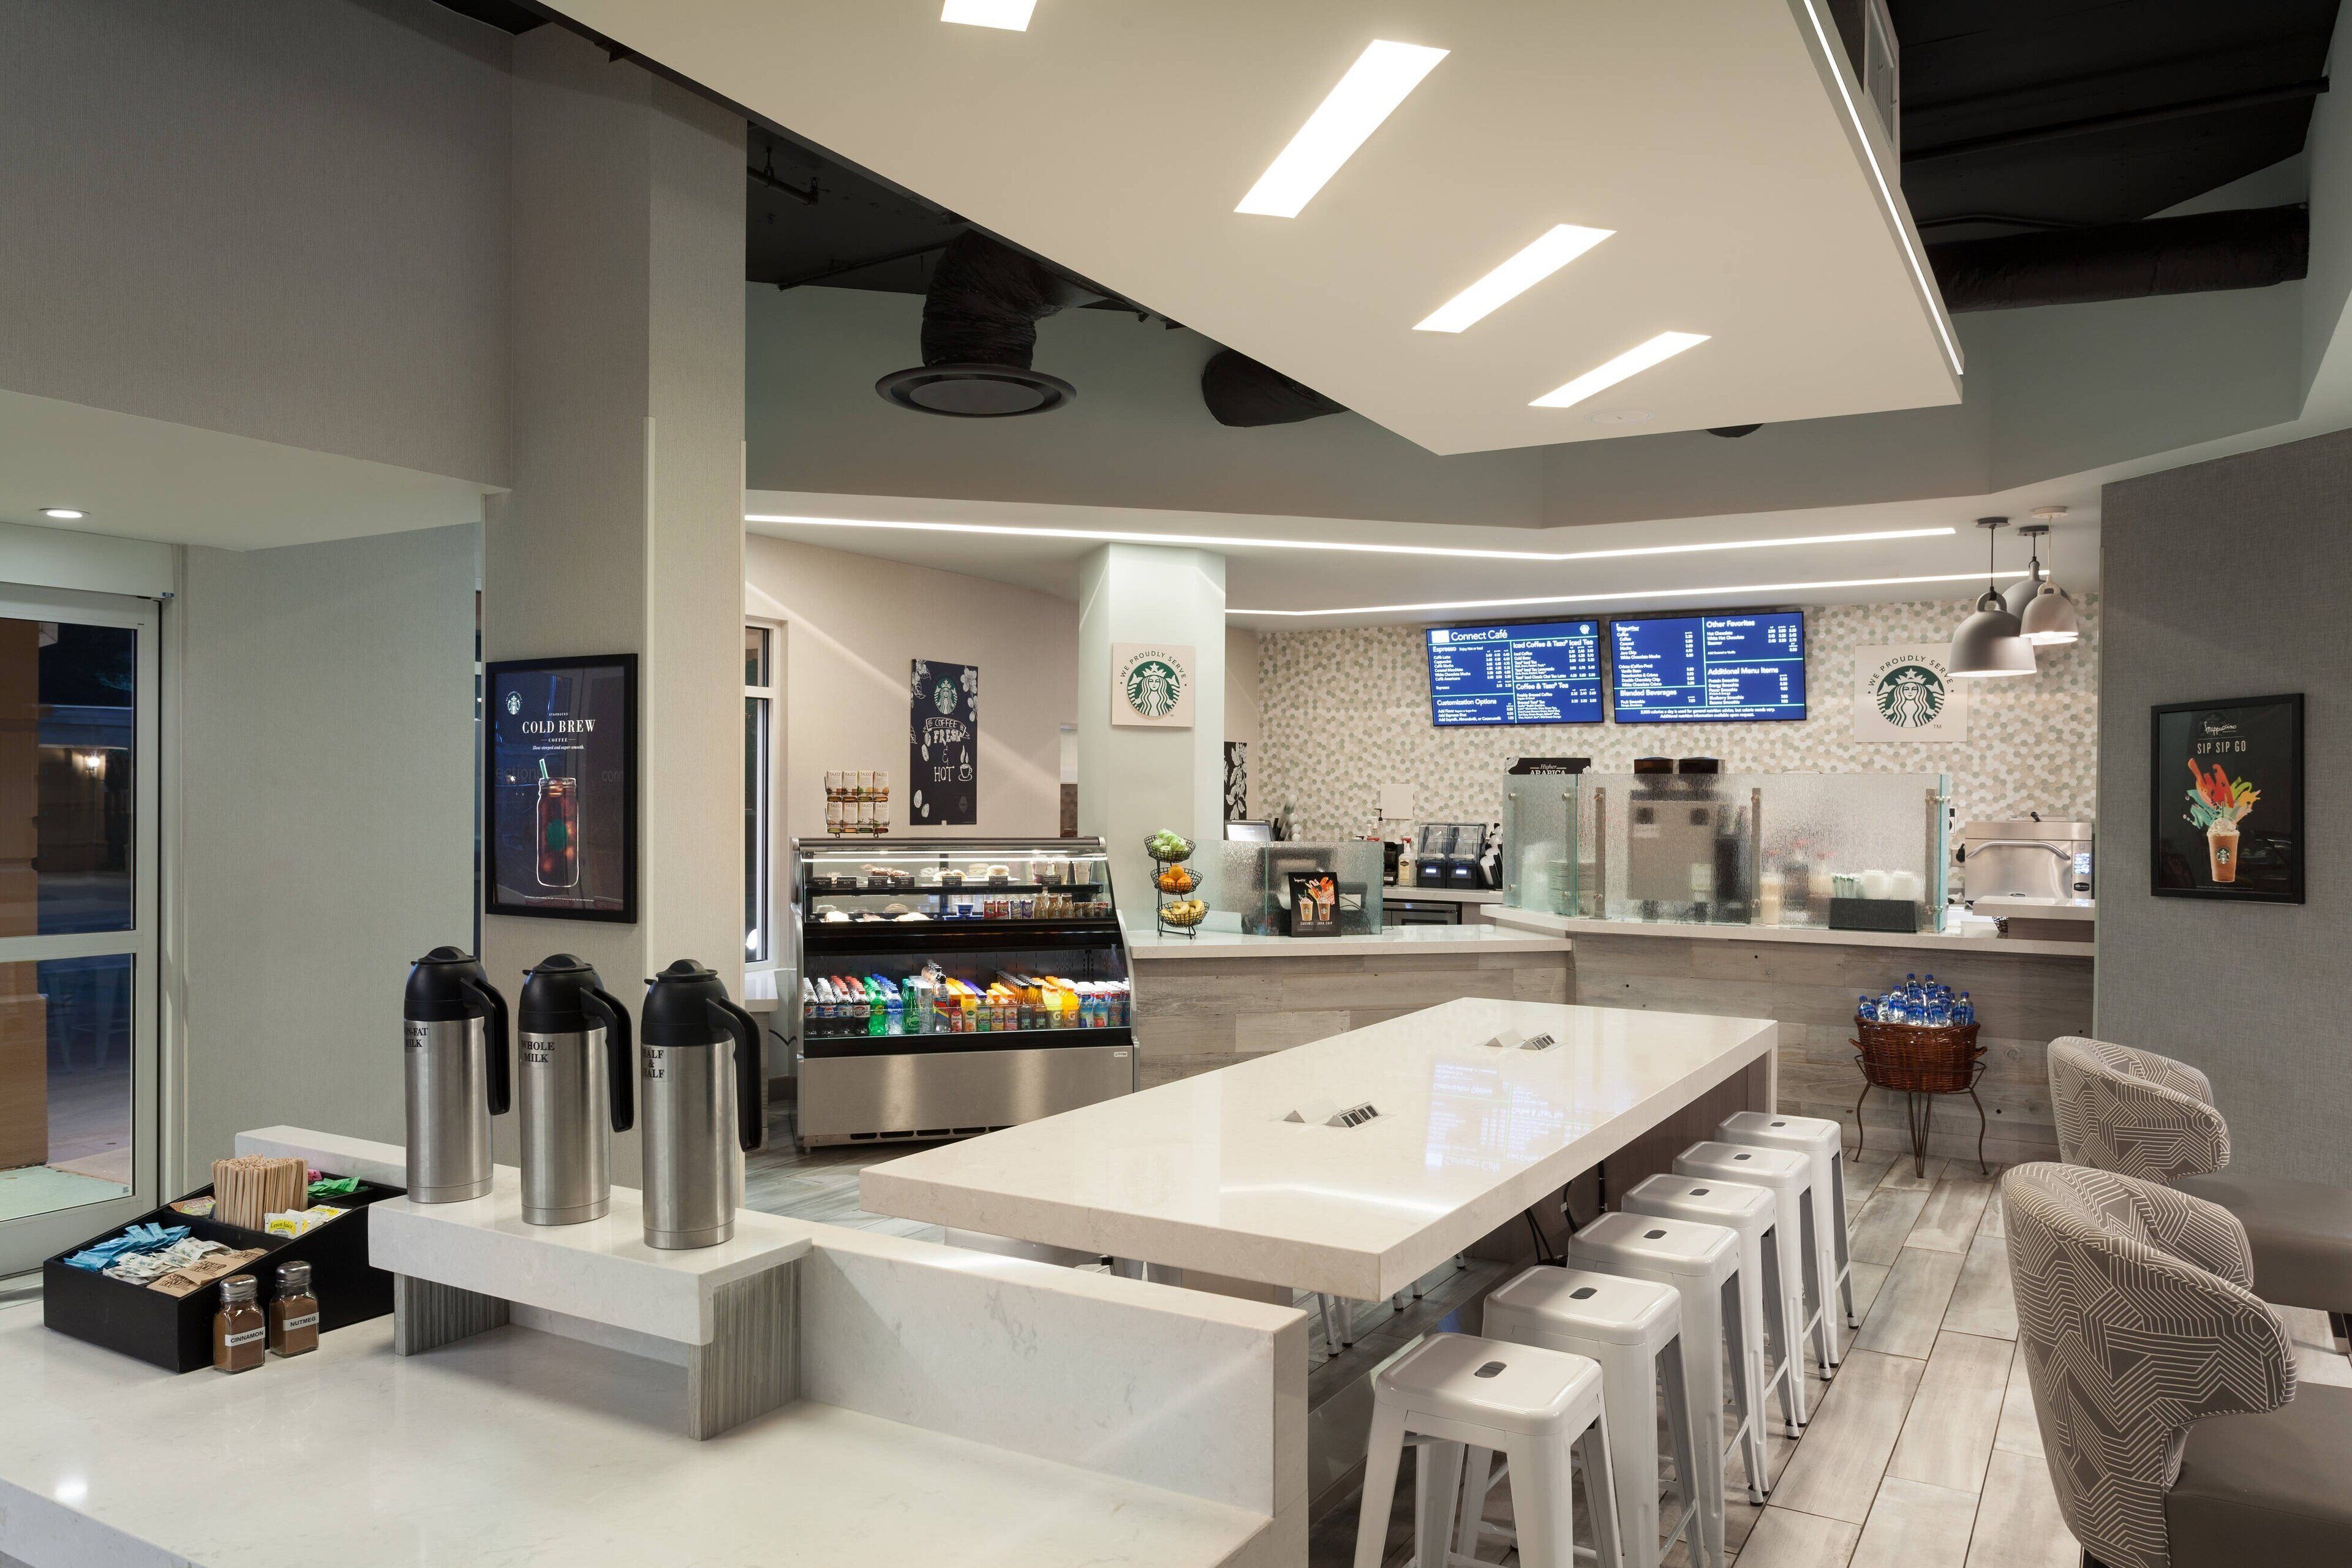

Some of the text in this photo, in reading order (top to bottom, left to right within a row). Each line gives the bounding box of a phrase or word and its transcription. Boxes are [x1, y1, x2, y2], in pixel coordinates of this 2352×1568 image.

[1451, 630, 1507, 641] Connect Café
[1120, 651, 1186, 679] WE PROUDLY SERVE
[1869, 655, 1953, 686] WE PROUDLY SERVE
[522, 719, 596, 733] COLD BREW
[935, 718, 957, 728] COFFEE
[2197, 741, 2247, 754] SIP SIP GO
[934, 766, 954, 782] HOT
[405, 1027, 429, 1036] N-FAT
[521, 1040, 555, 1050] WHOLE
[524, 1053, 549, 1063] MILK
[643, 1049, 664, 1058] HALF
[649, 1059, 654, 1068] &
[643, 1068, 665, 1078] HALF
[290, 1316, 316, 1327] NUTMEG
[230, 1330, 264, 1343] CINNAMON
